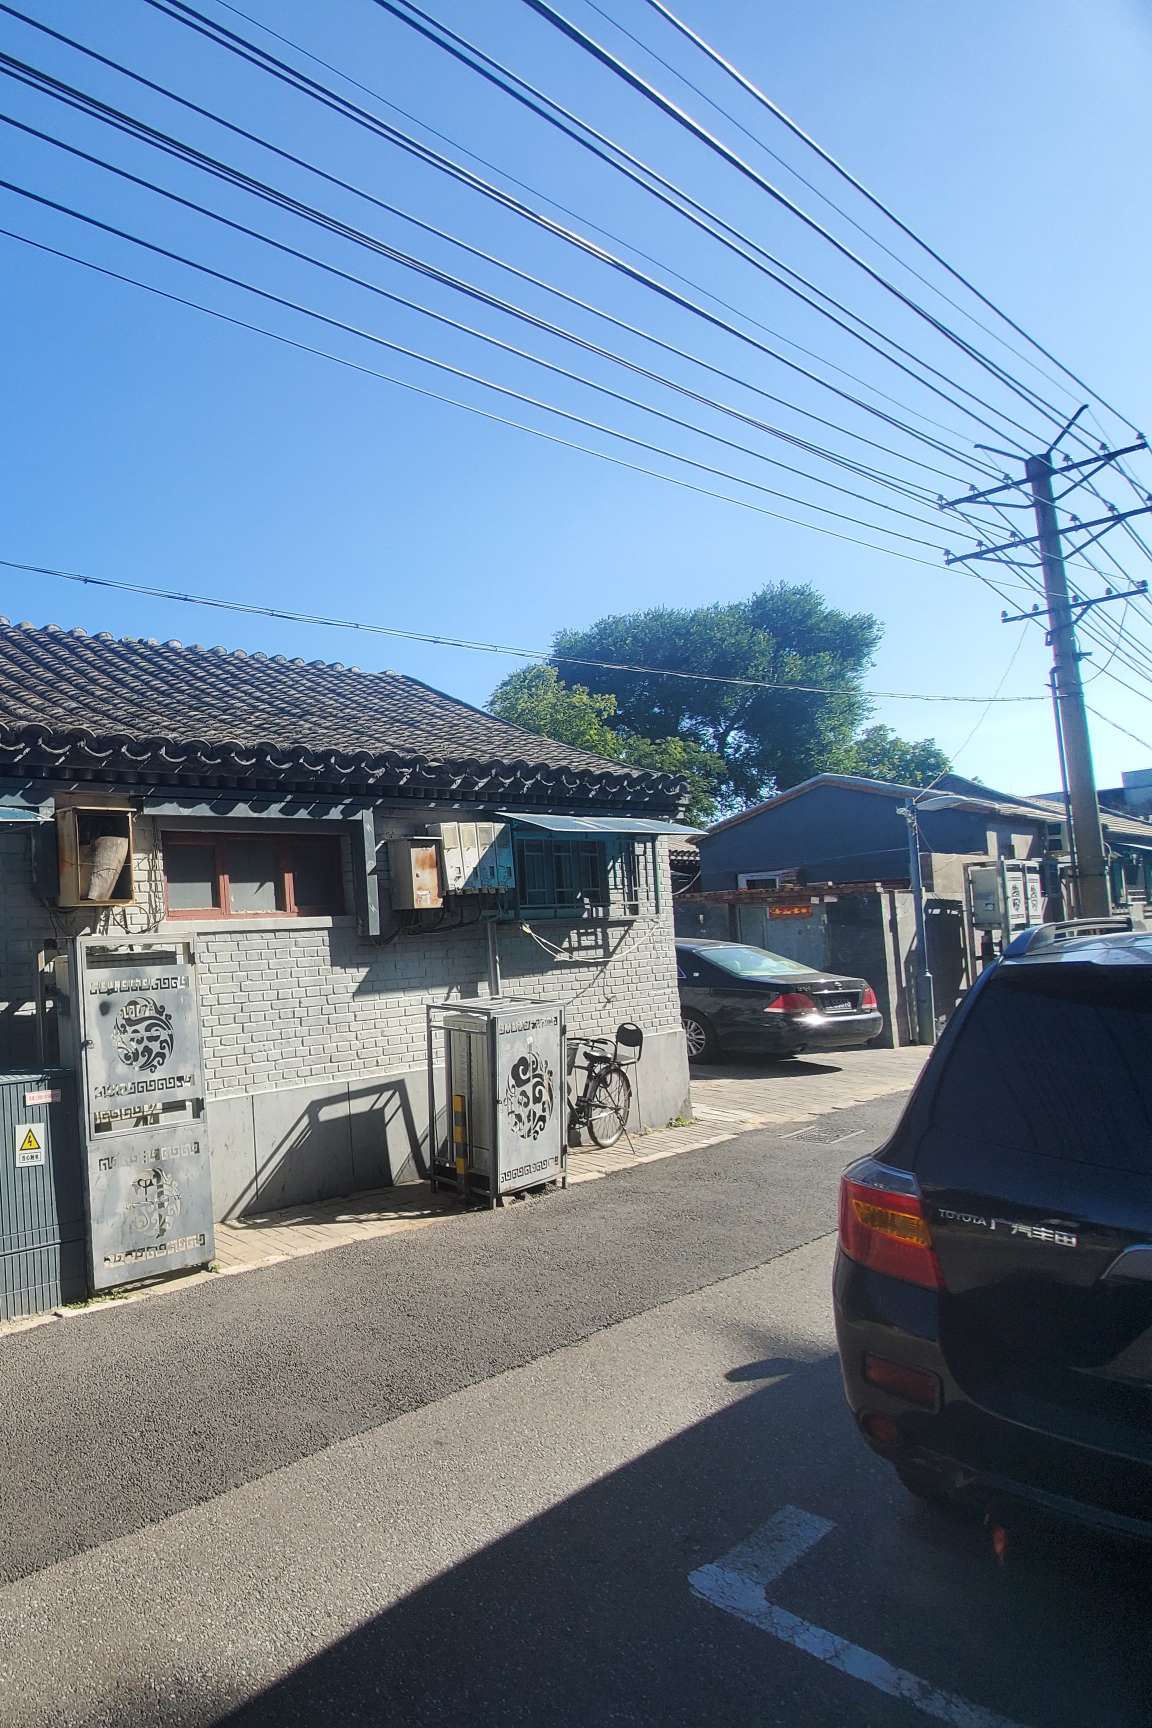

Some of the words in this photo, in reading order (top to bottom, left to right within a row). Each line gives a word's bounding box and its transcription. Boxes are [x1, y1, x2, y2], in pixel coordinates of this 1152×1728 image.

[938, 1208, 987, 1226] TOYOTA
[989, 1216, 1077, 1247] 广汽丰田
